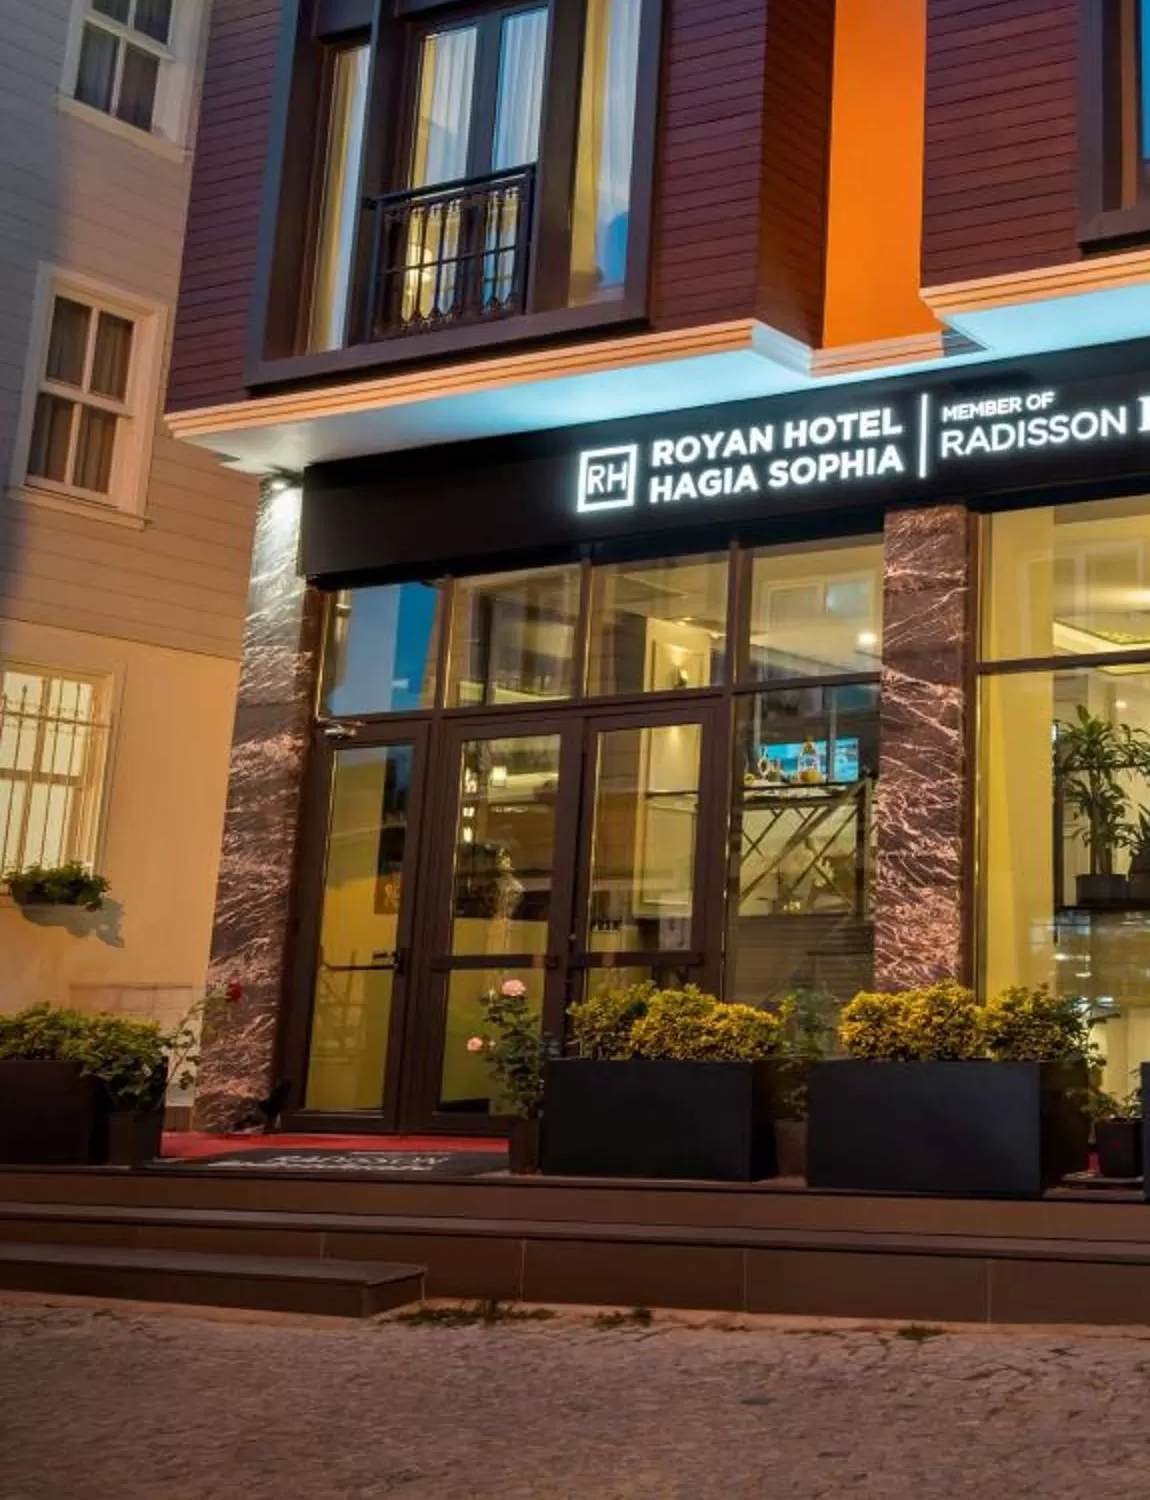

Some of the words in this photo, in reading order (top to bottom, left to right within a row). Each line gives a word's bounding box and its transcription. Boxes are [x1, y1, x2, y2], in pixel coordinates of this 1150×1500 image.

[941, 406, 1127, 458] RADISSON
[943, 397, 1022, 423] MEMBER
[1026, 392, 1054, 412] OF
[652, 425, 773, 467] ROYAN
[784, 408, 903, 448] HOTEL
[587, 461, 628, 494] RH
[650, 465, 759, 503] HAGIA
[768, 445, 905, 488] SOPHIA
